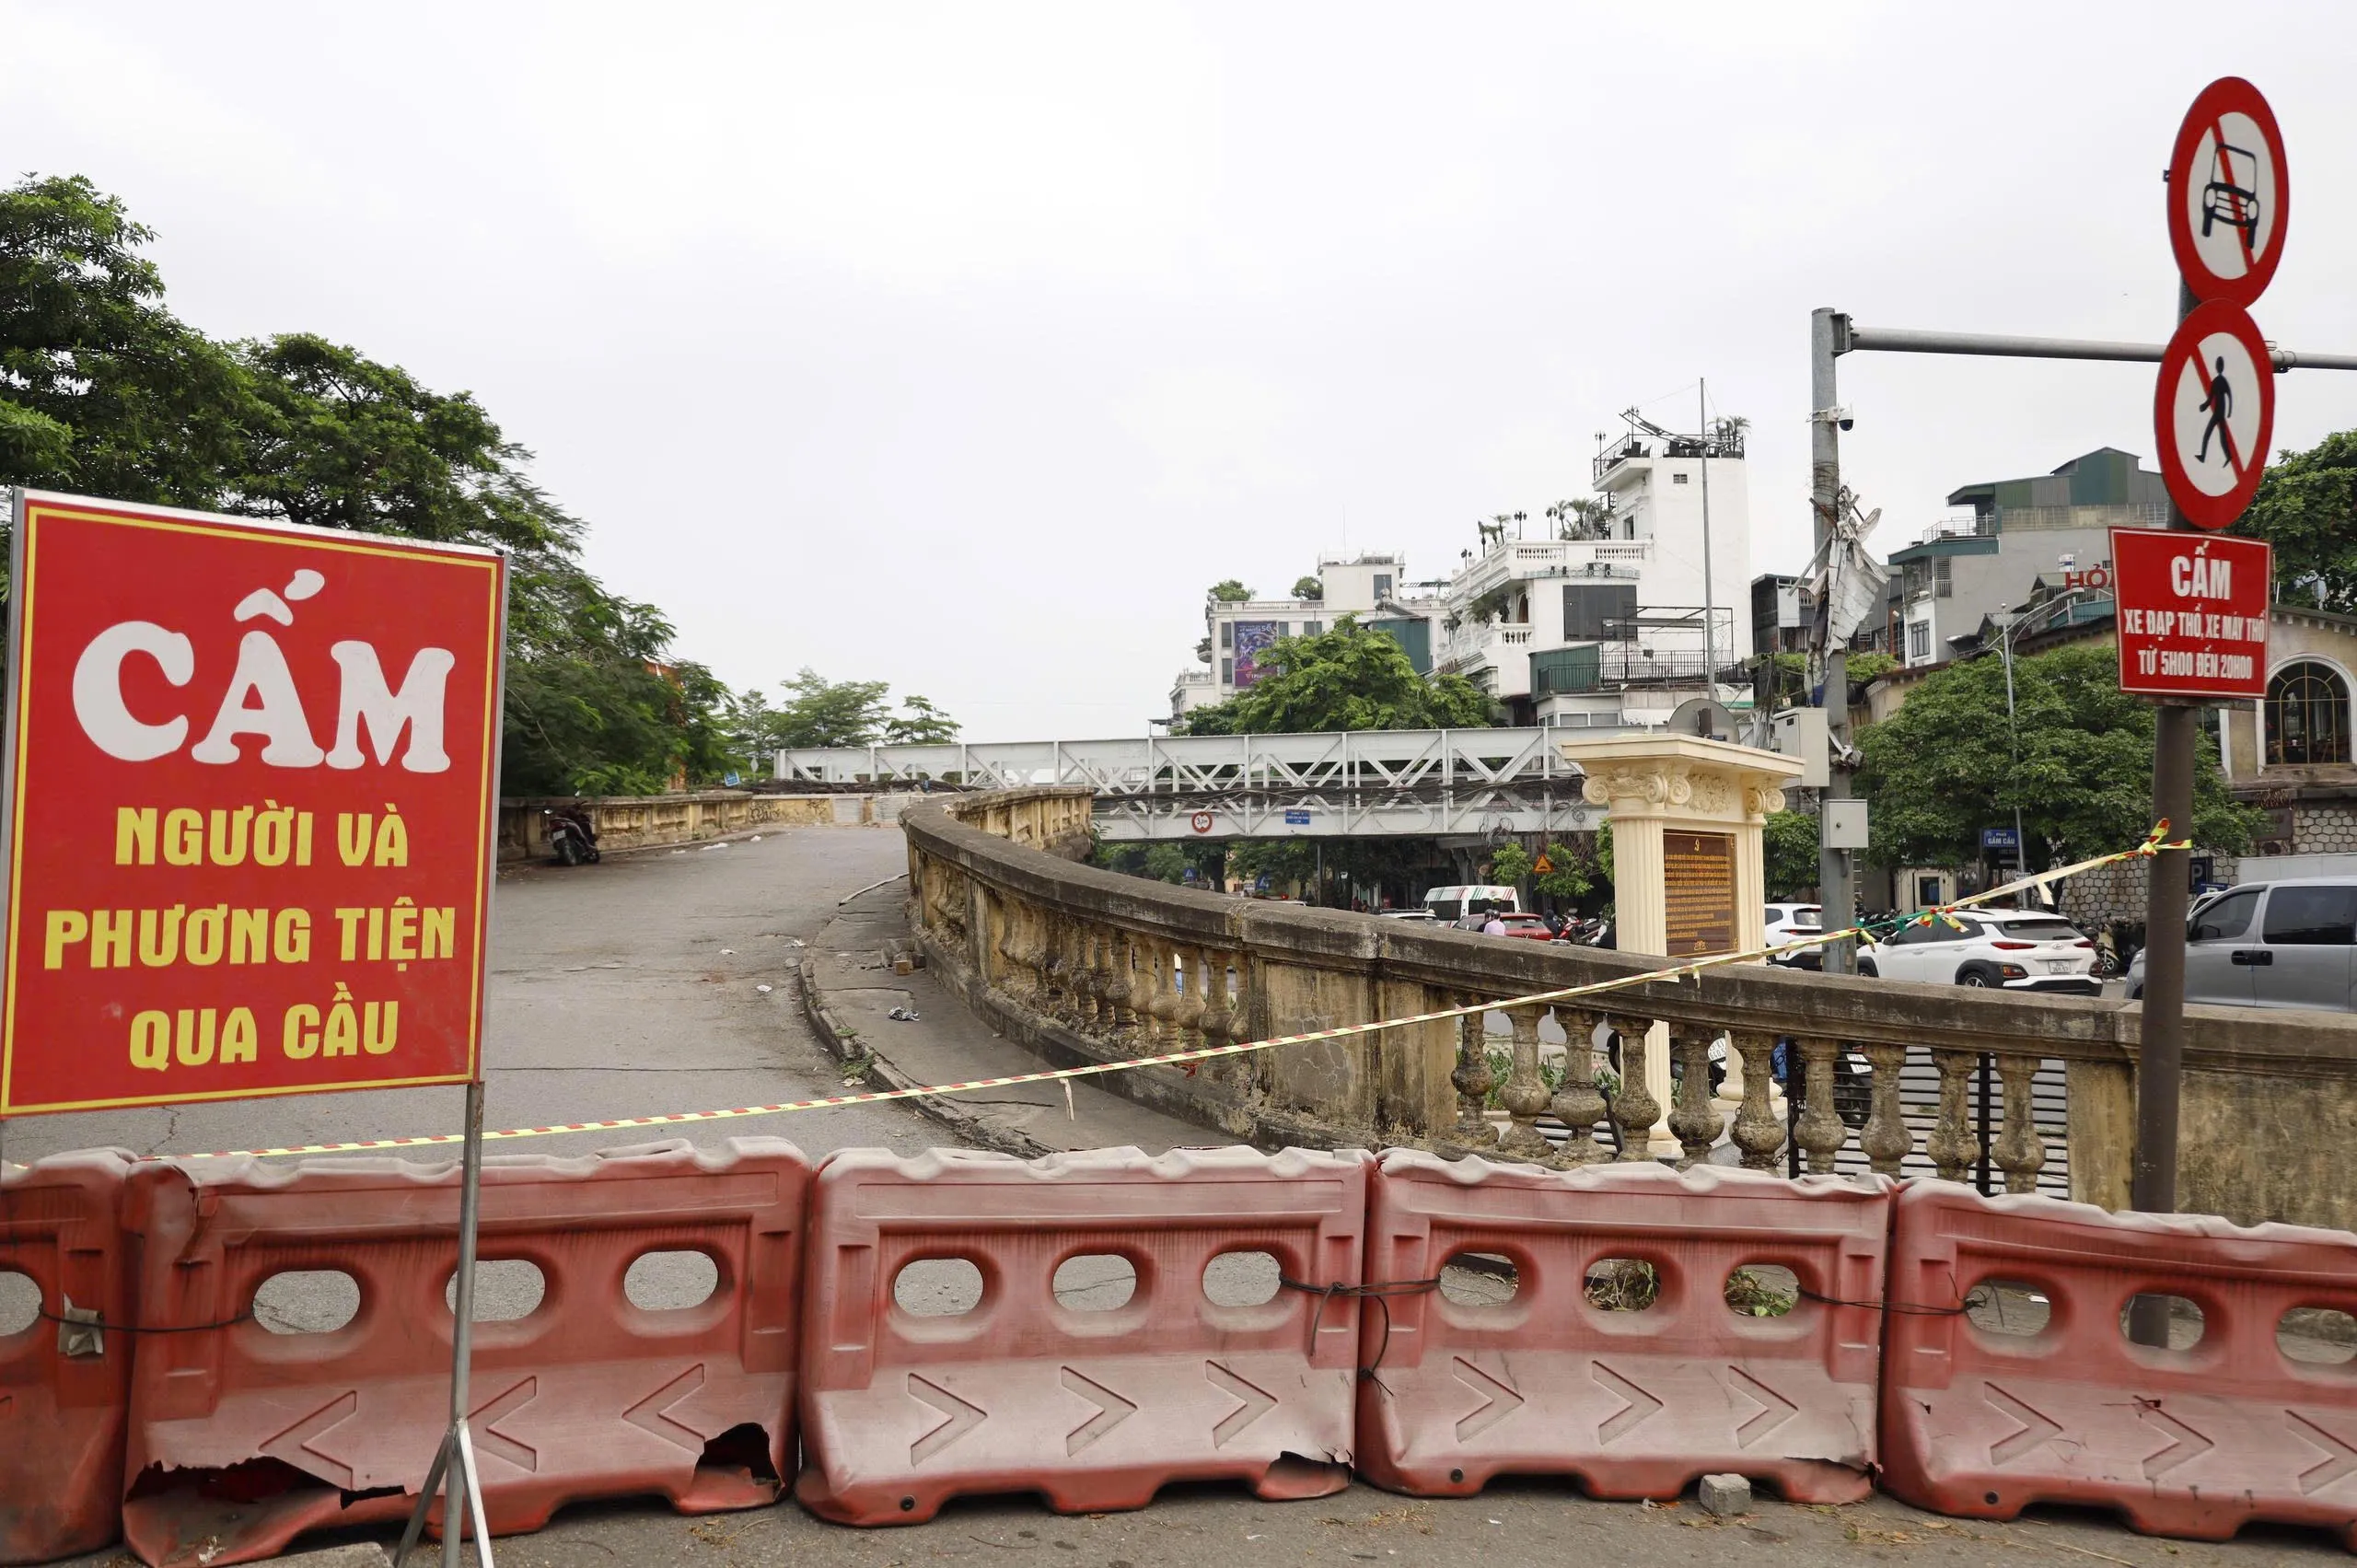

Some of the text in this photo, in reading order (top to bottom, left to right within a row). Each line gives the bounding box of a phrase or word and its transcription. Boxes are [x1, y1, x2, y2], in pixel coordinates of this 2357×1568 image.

[2065, 563, 2114, 590] HỎ
[2171, 540, 2232, 599] CẤM
[2124, 609, 2143, 633] XE
[2146, 610, 2175, 641] ĐẠP
[2205, 614, 2220, 639] XE
[2223, 611, 2244, 640] MÁY
[2247, 610, 2266, 643] THỔ
[73, 569, 455, 773] CẤM
[2138, 645, 2252, 679] TỪ 5H00 ĐẾN 20H00
[115, 799, 409, 867] NGƯỜI VÀ
[44, 898, 456, 971] PHƯƠNG TIỆN
[129, 981, 399, 1072] QUA CẦU
